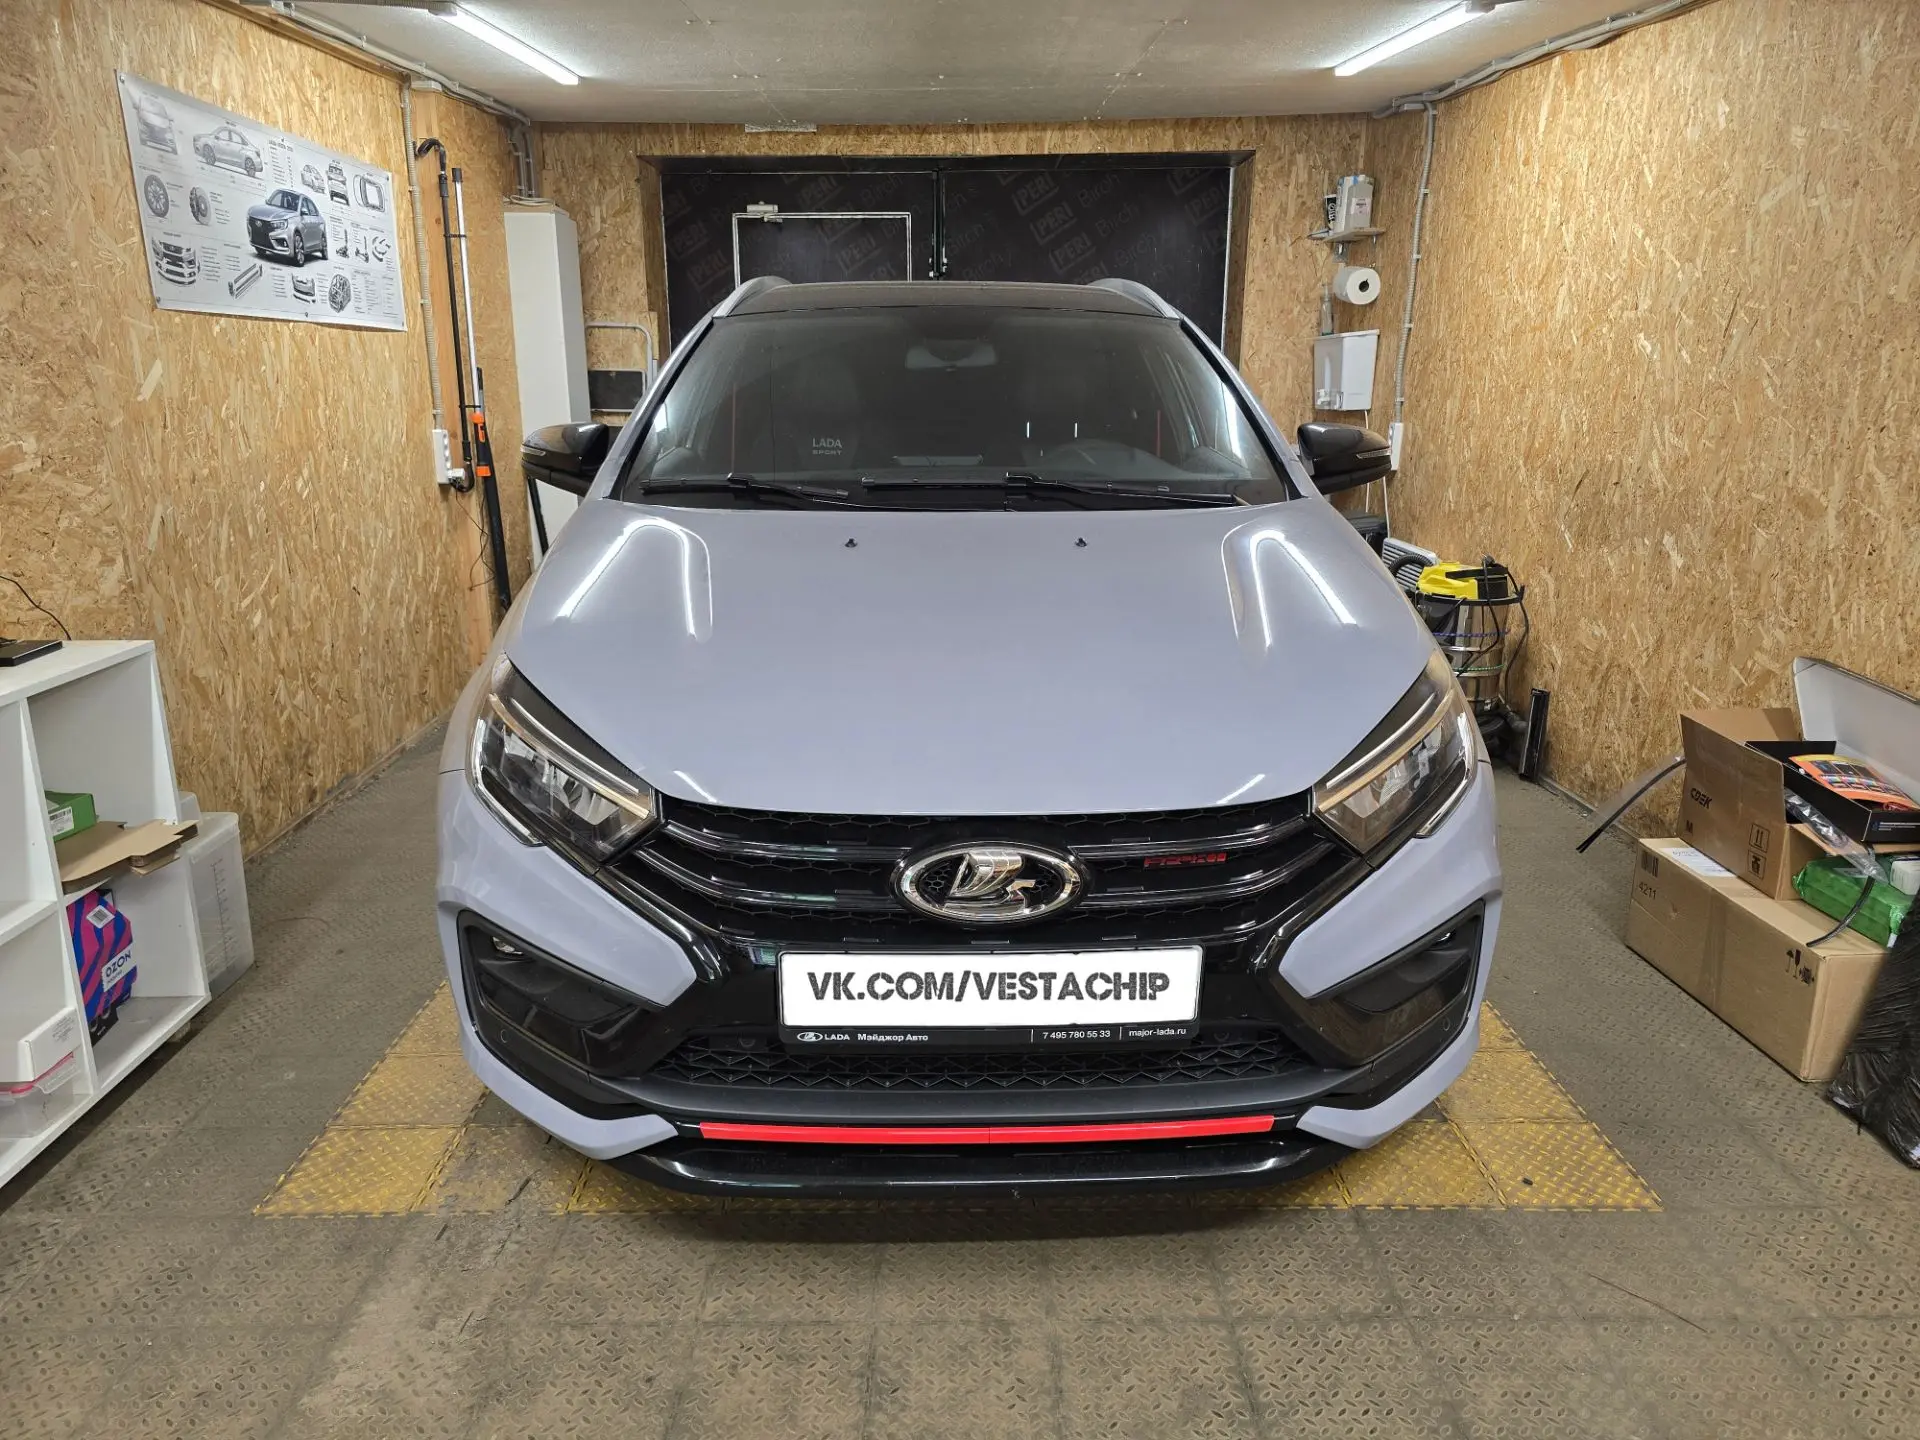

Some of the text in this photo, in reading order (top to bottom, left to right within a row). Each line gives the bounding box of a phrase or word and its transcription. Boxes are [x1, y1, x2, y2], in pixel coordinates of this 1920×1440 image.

[1036, 173, 1121, 237] PERI Birch
[1054, 201, 1140, 267] PERI Birch
[812, 437, 843, 449] LADA
[1690, 787, 1713, 810] CDEK
[1685, 819, 1694, 834] M
[1638, 881, 1657, 900] 4211
[105, 950, 132, 978] OZON
[824, 1033, 851, 1041] LADA
[857, 1033, 929, 1042] Мэйджор Авто
[1050, 1031, 1067, 1039] 495
[1068, 1031, 1085, 1039] 780
[1086, 1030, 1098, 1038] 55
[1099, 1030, 1111, 1038] 33
[1129, 1027, 1187, 1037] major-lada.ru
